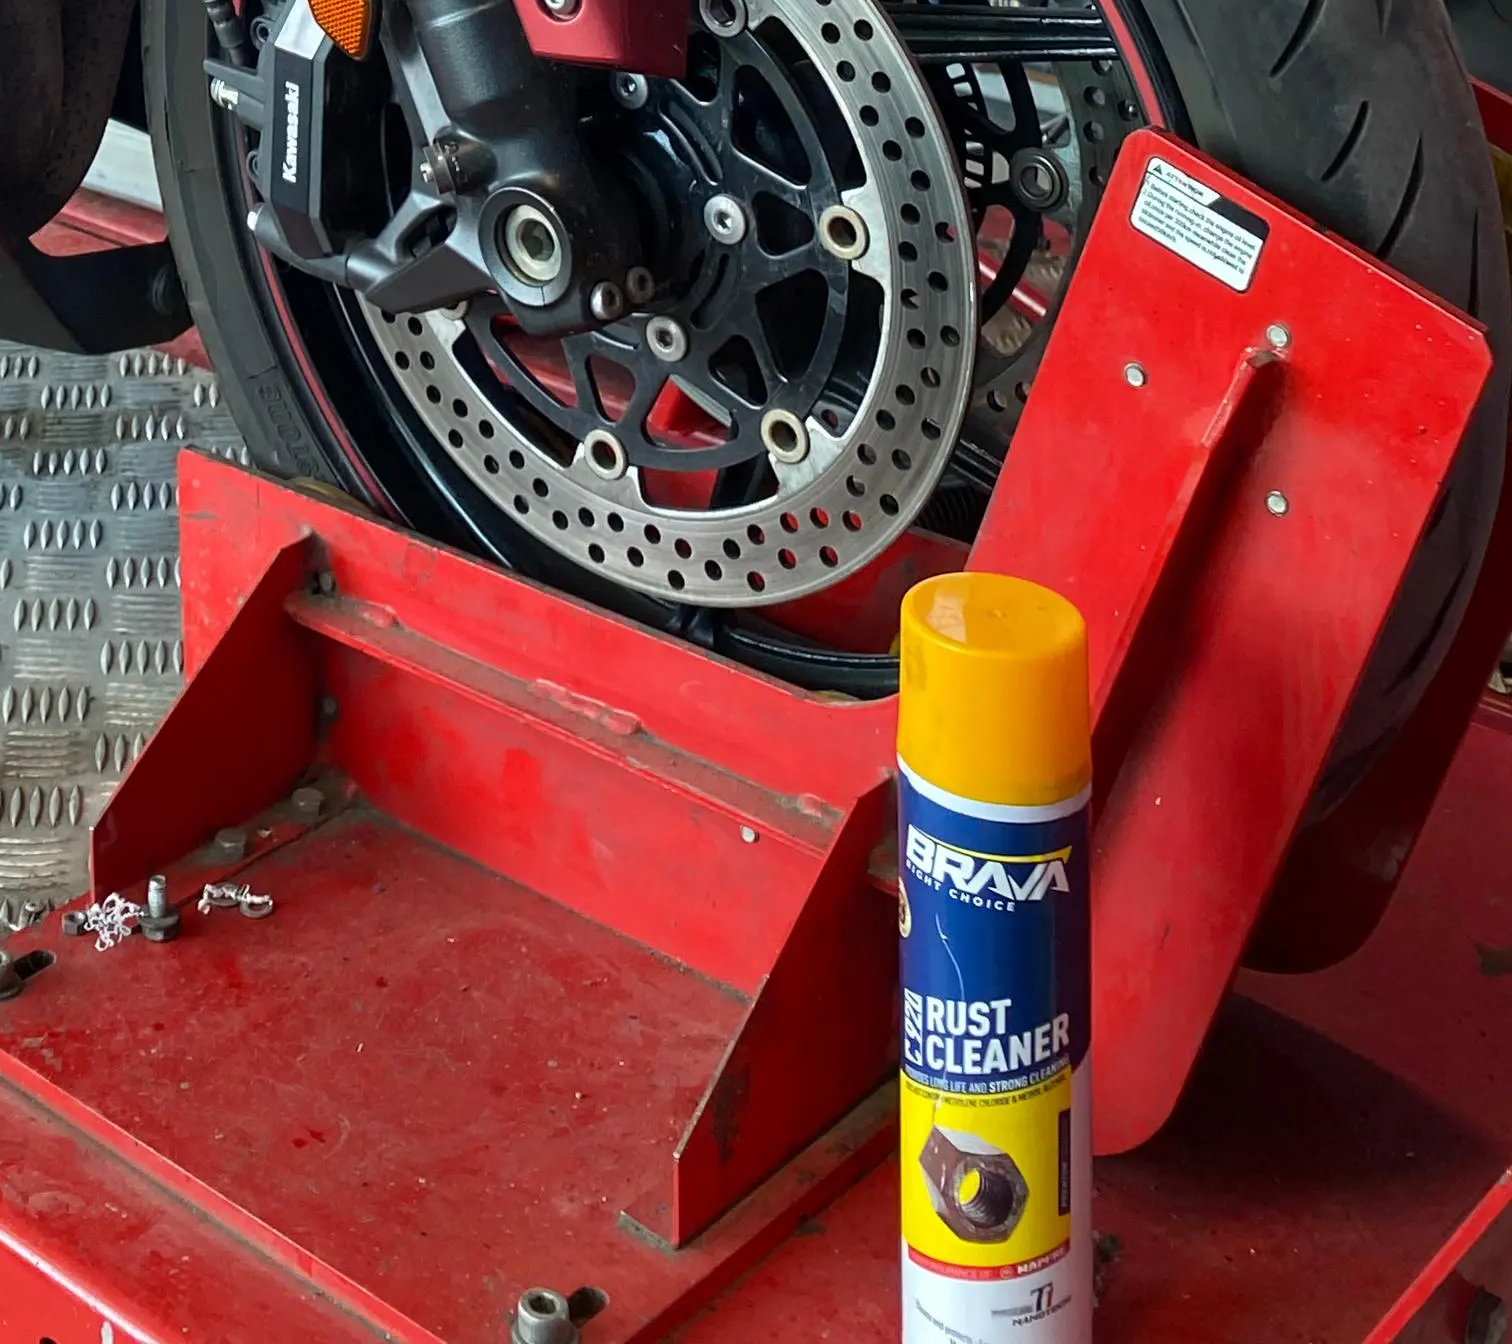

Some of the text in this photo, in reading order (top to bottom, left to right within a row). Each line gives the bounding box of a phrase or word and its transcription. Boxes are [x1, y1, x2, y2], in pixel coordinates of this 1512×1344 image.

[282, 80, 300, 184] Kawasaki
[905, 858, 1016, 913] RIGHT CHOICE
[906, 823, 1071, 901] BRAVA
[925, 1012, 1070, 1075] CLEANER
[926, 996, 1013, 1037] RUST
[988, 1075, 1028, 1094] STRONG
